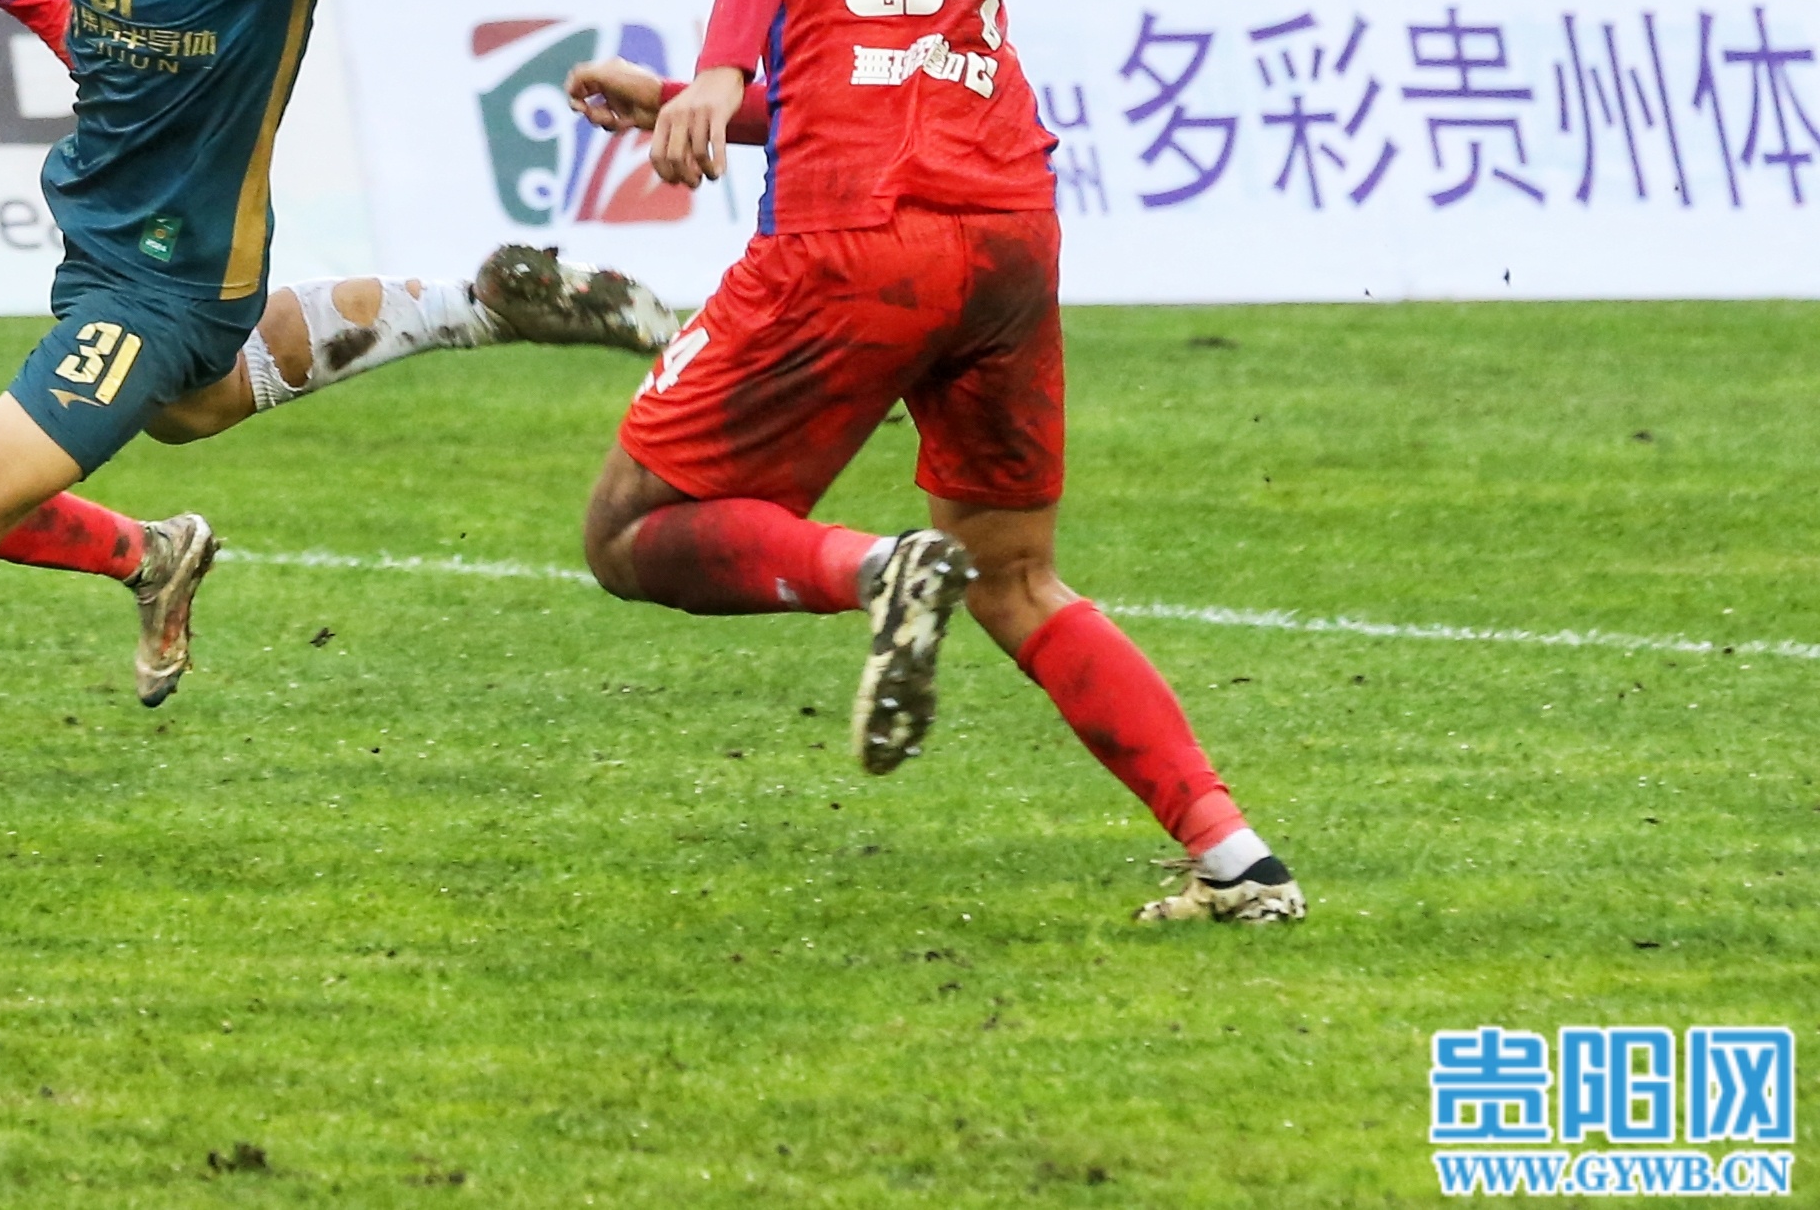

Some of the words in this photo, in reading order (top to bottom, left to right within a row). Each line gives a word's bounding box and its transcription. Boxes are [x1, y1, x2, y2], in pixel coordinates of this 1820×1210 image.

[1120, 6, 1820, 208] 多彩贵州体
[55, 320, 143, 407] 31
